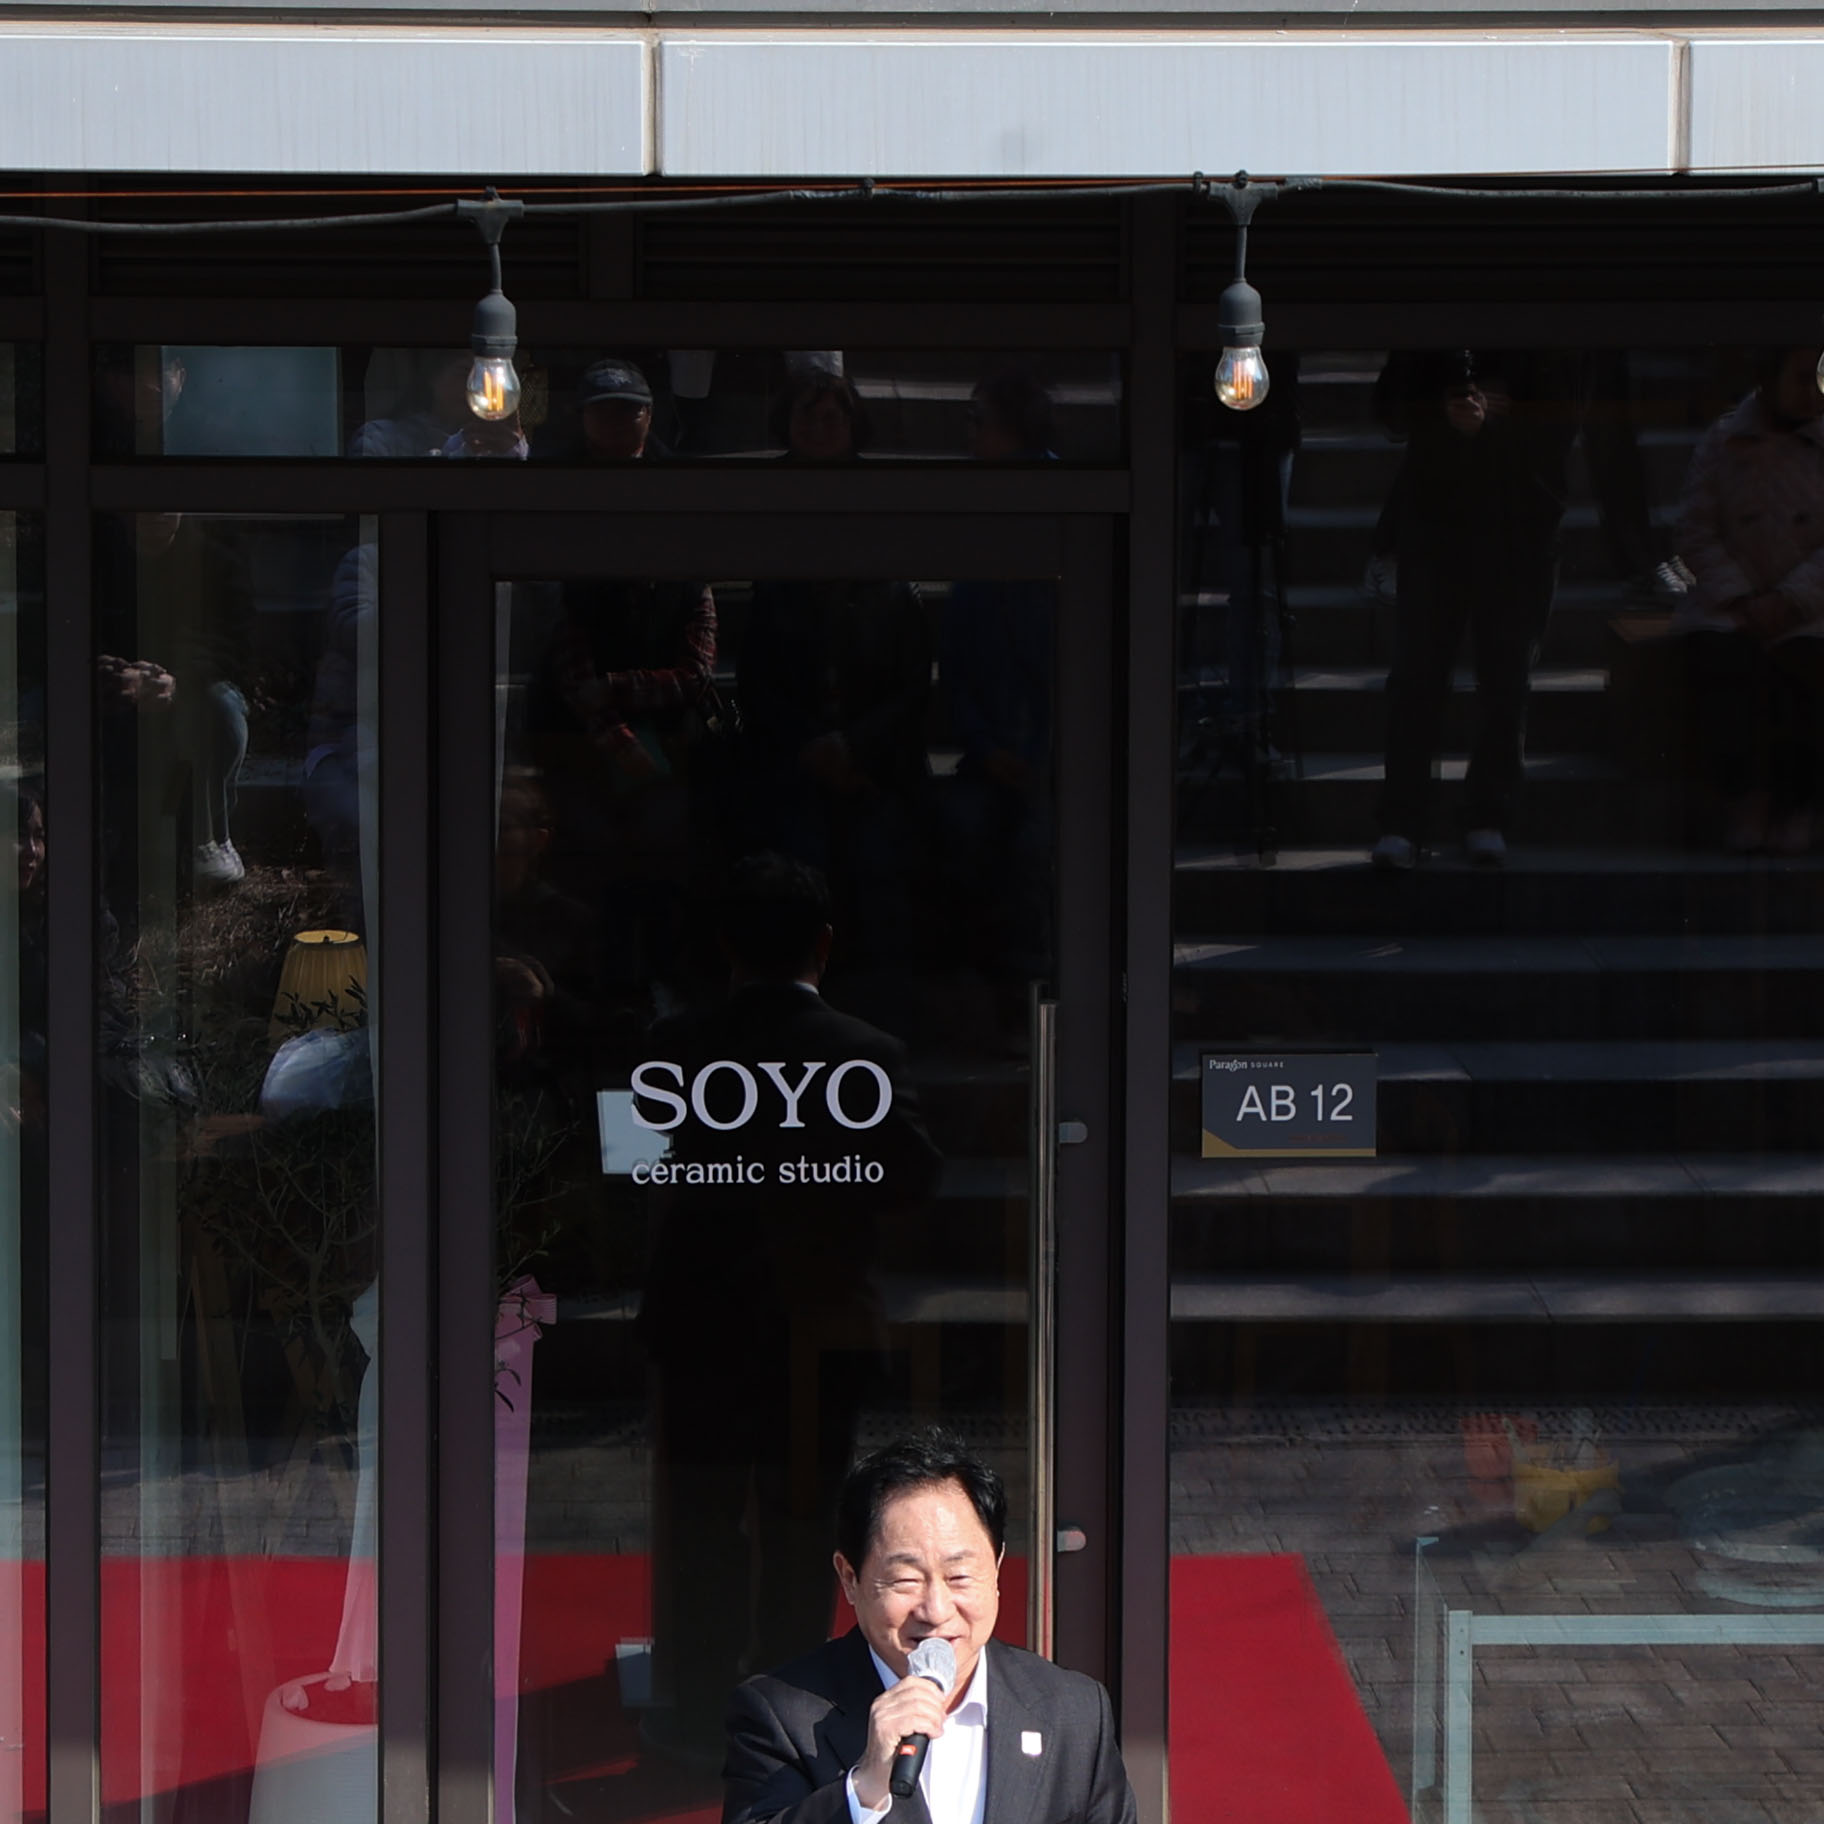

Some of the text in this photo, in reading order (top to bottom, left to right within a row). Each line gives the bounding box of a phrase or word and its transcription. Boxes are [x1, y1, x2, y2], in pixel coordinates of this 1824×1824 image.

[1209, 1059, 1247, 1072] Paragon
[631, 1060, 892, 1130] SOYO
[1236, 1083, 1353, 1121] AB 12
[631, 1154, 884, 1184] ceramic studio
